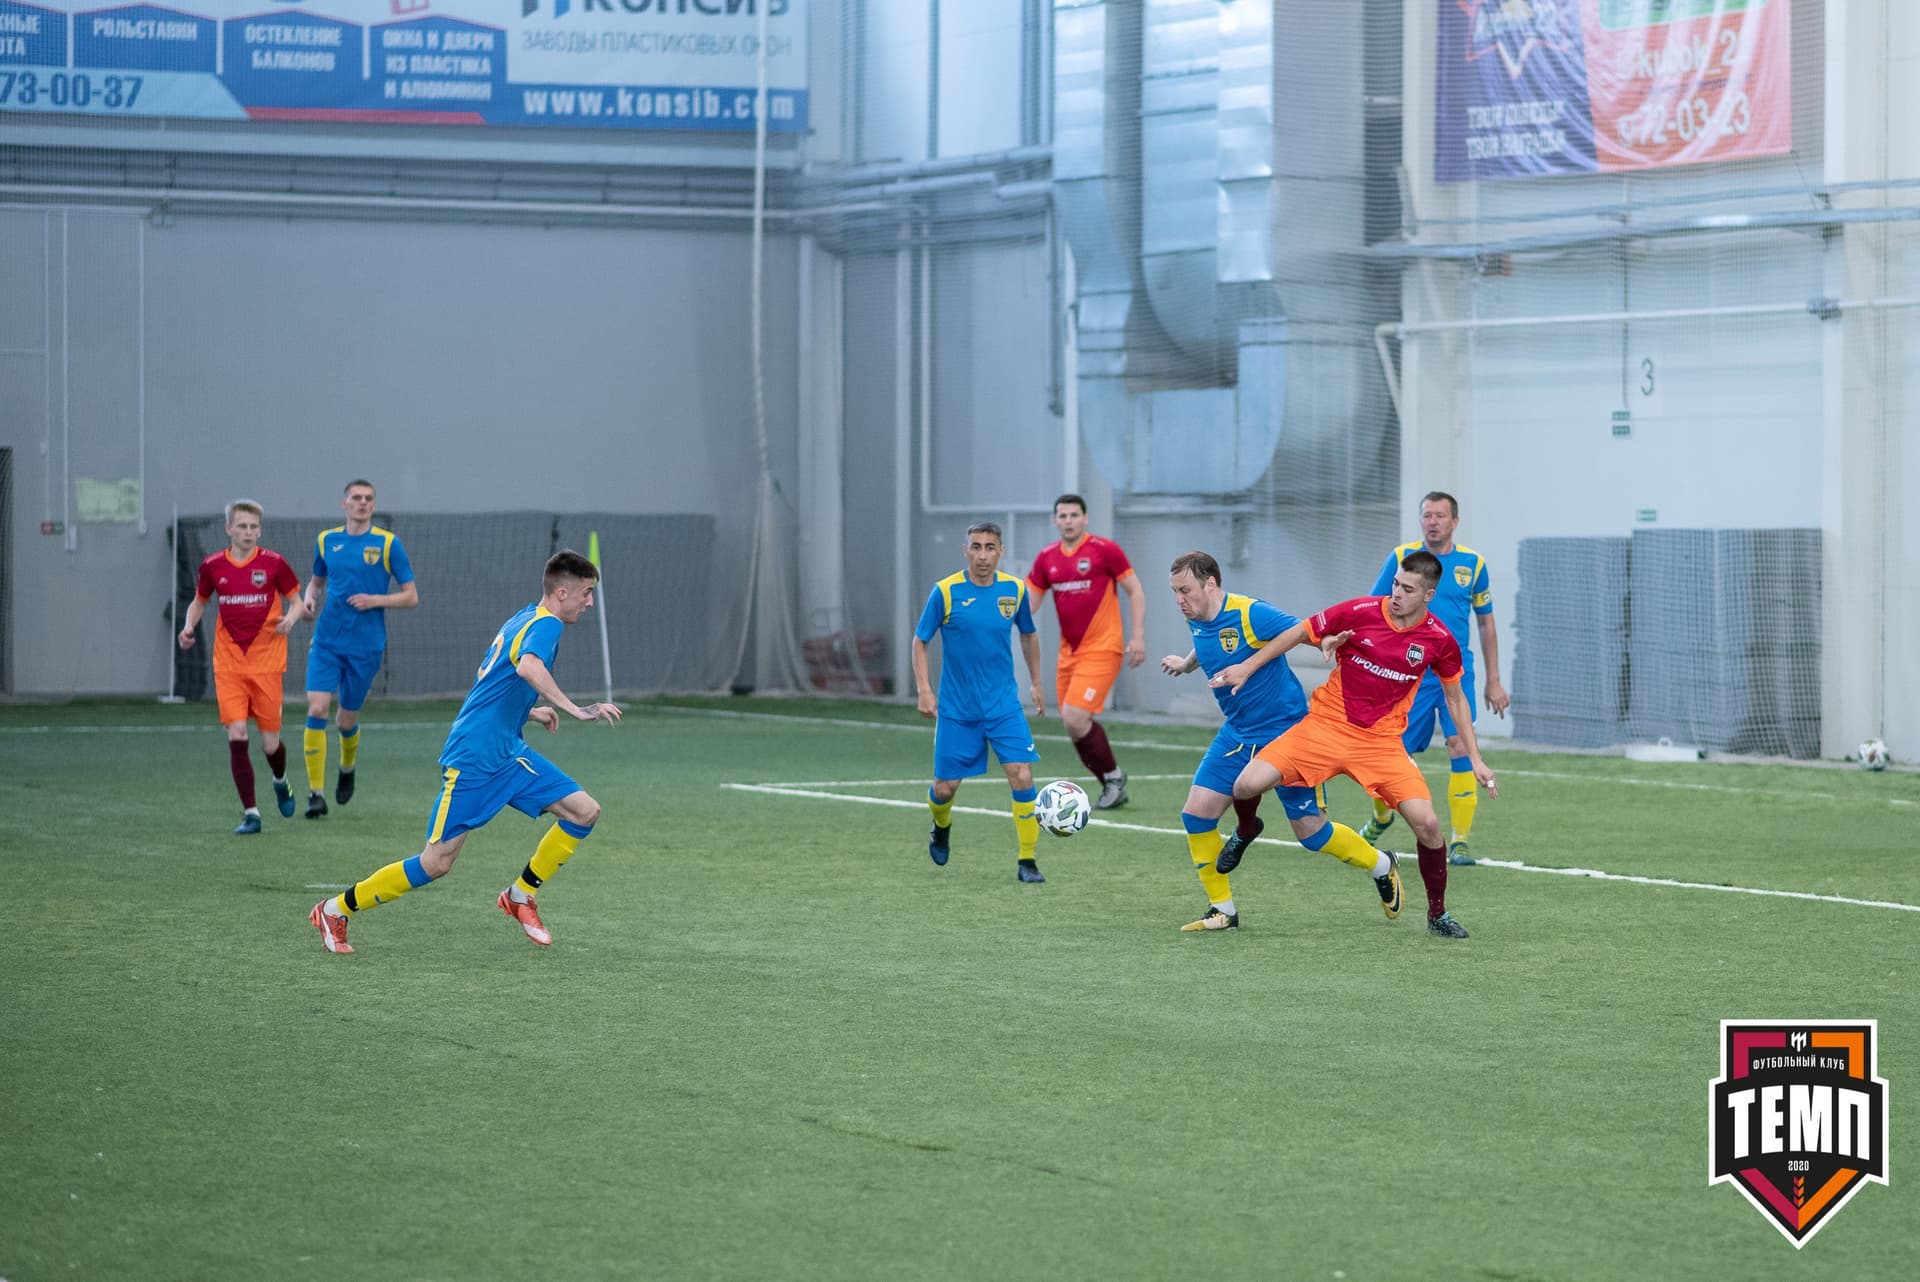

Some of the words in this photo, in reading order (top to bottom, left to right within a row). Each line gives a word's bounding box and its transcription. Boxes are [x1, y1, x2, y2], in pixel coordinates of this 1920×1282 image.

[93, 18, 197, 41] РОЛЬСТАВНИ
[245, 23, 342, 47] ОСТЕКЛЕНИЕ
[603, 32, 736, 57] ПЛАСТИКОВЫХ
[741, 34, 793, 57] ООН
[252, 49, 336, 72] БАЛКОНОВ
[410, 55, 492, 76] ПЛАСТИКА
[0, 70, 144, 108] 73-00-37
[523, 88, 795, 120] www.konsib.cm
[1640, 358, 1655, 396] 3
